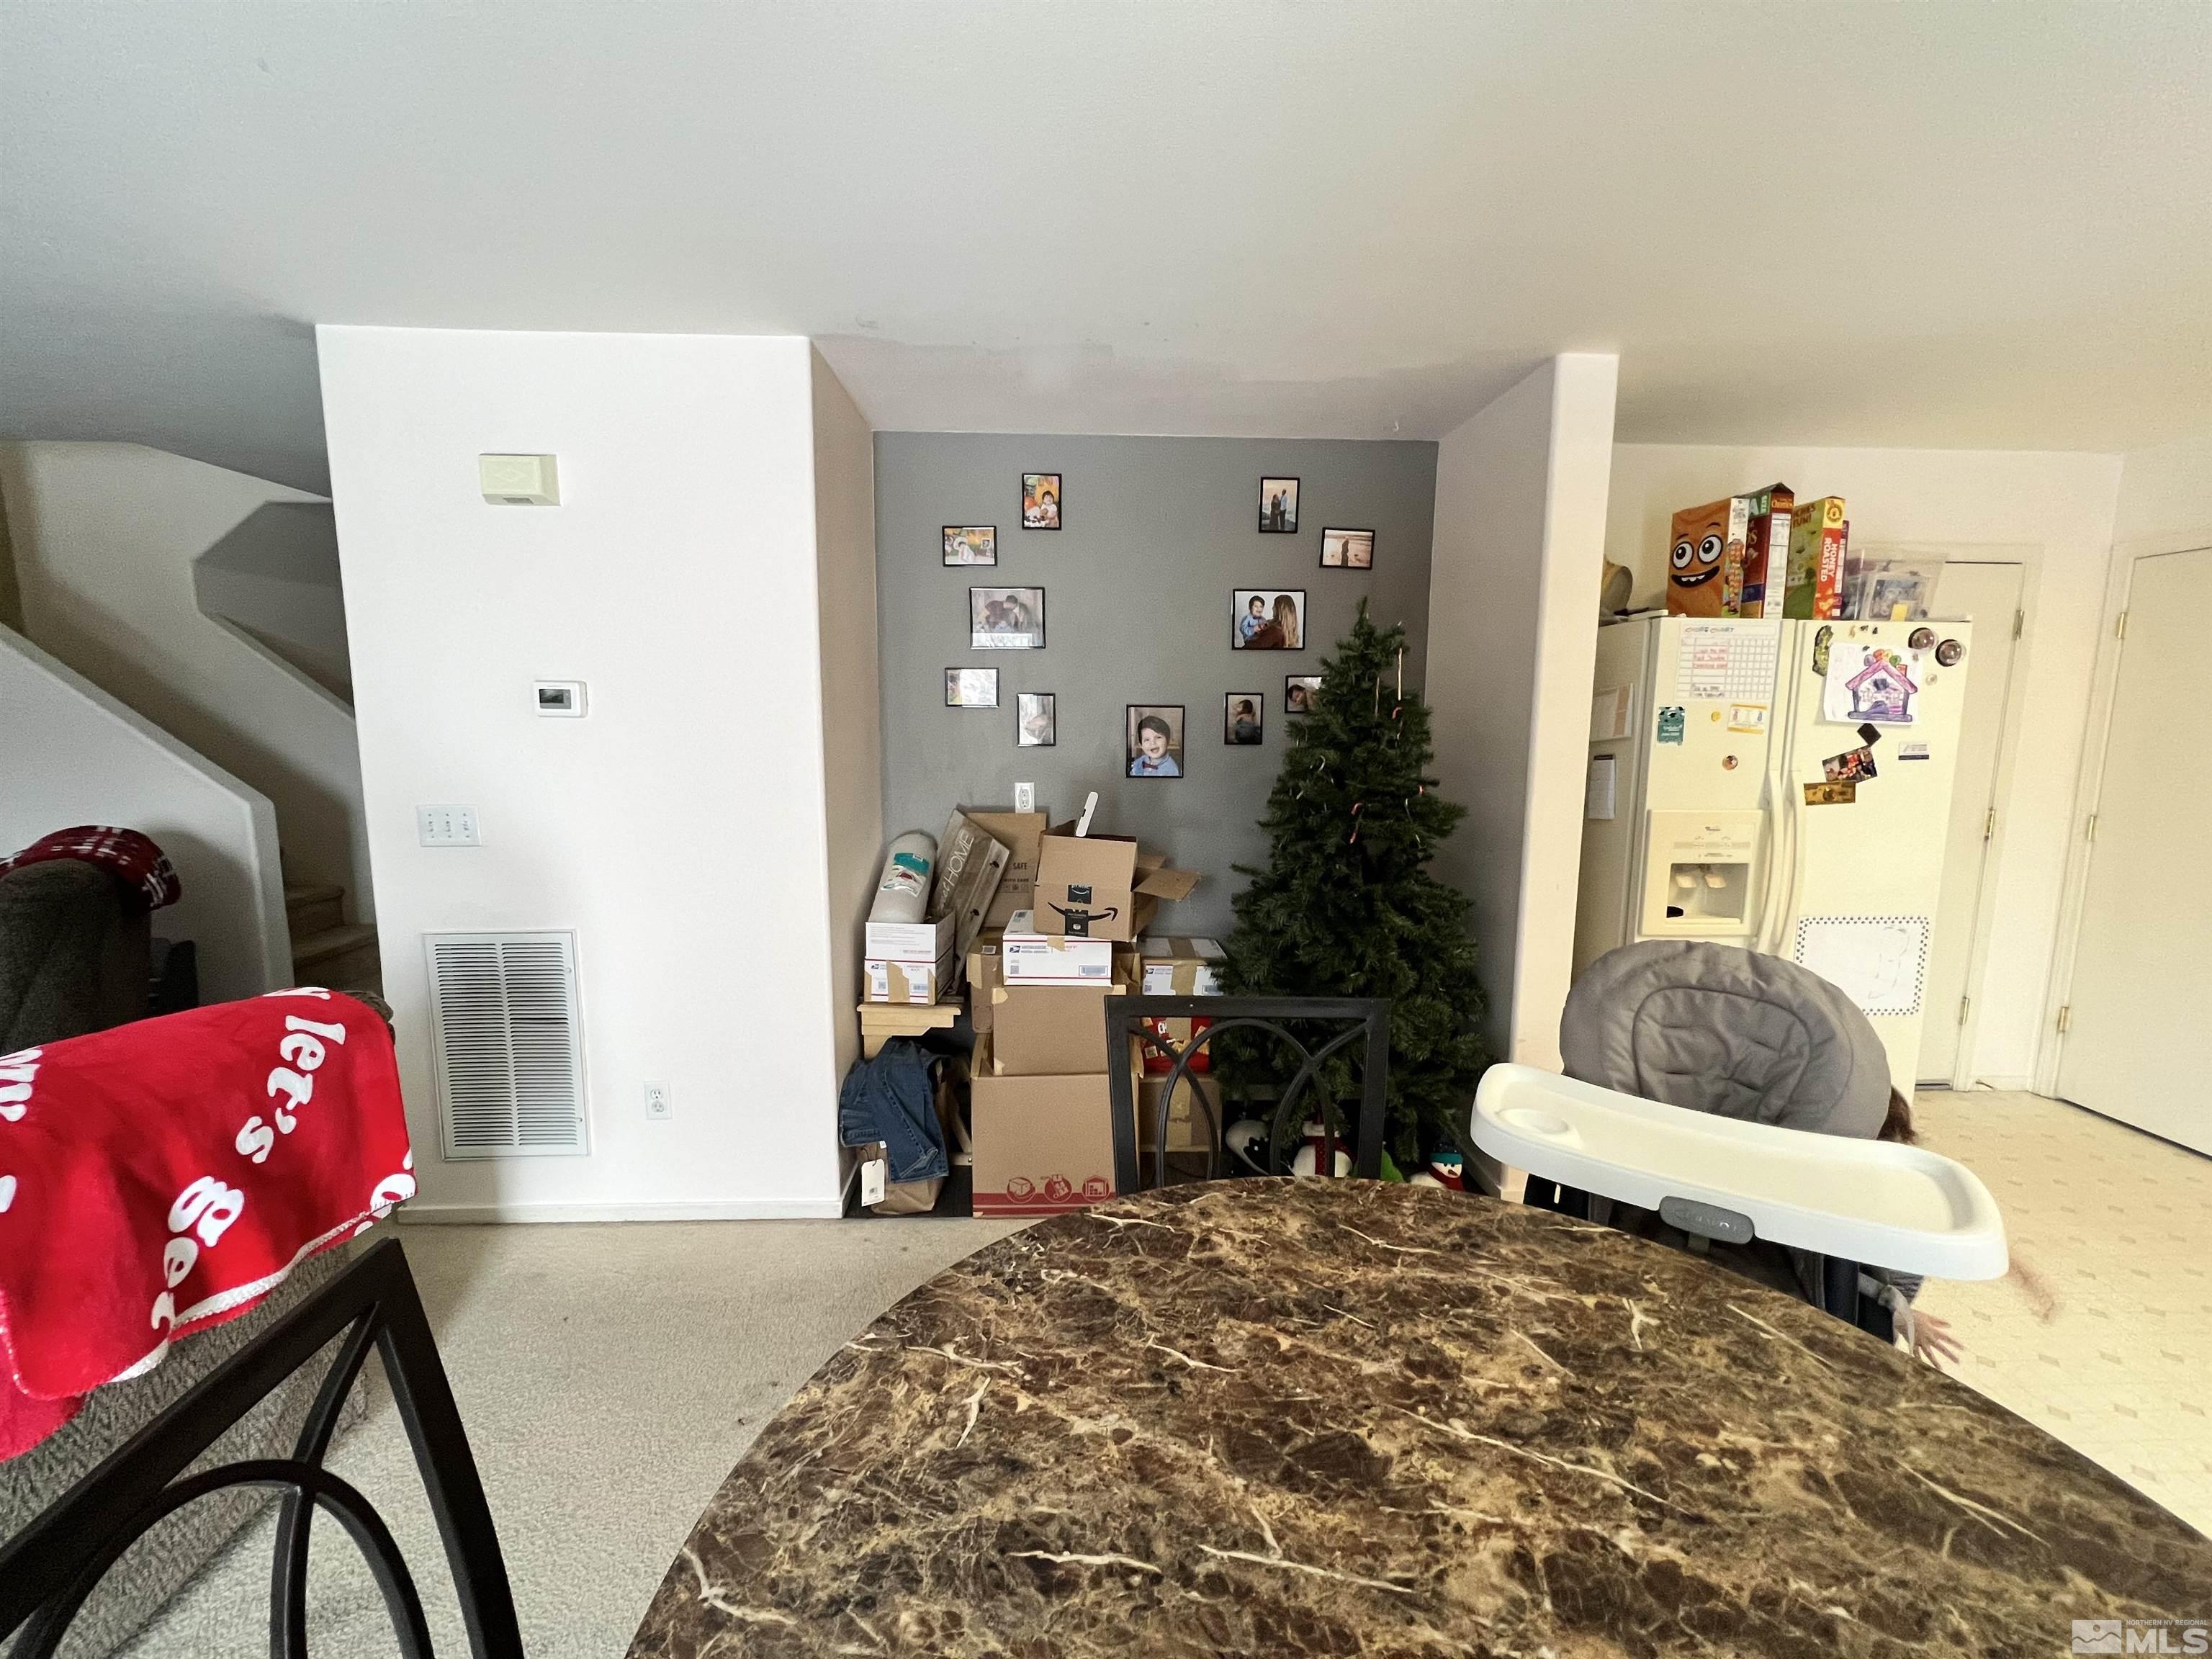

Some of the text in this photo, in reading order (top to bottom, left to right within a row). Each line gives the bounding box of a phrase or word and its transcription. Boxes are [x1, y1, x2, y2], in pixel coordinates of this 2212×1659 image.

[1820, 537, 1833, 583] ROASTED
[1828, 542, 1838, 577] HONEY
[943, 829, 974, 887] HOME
[235, 1015, 346, 1164] let's
